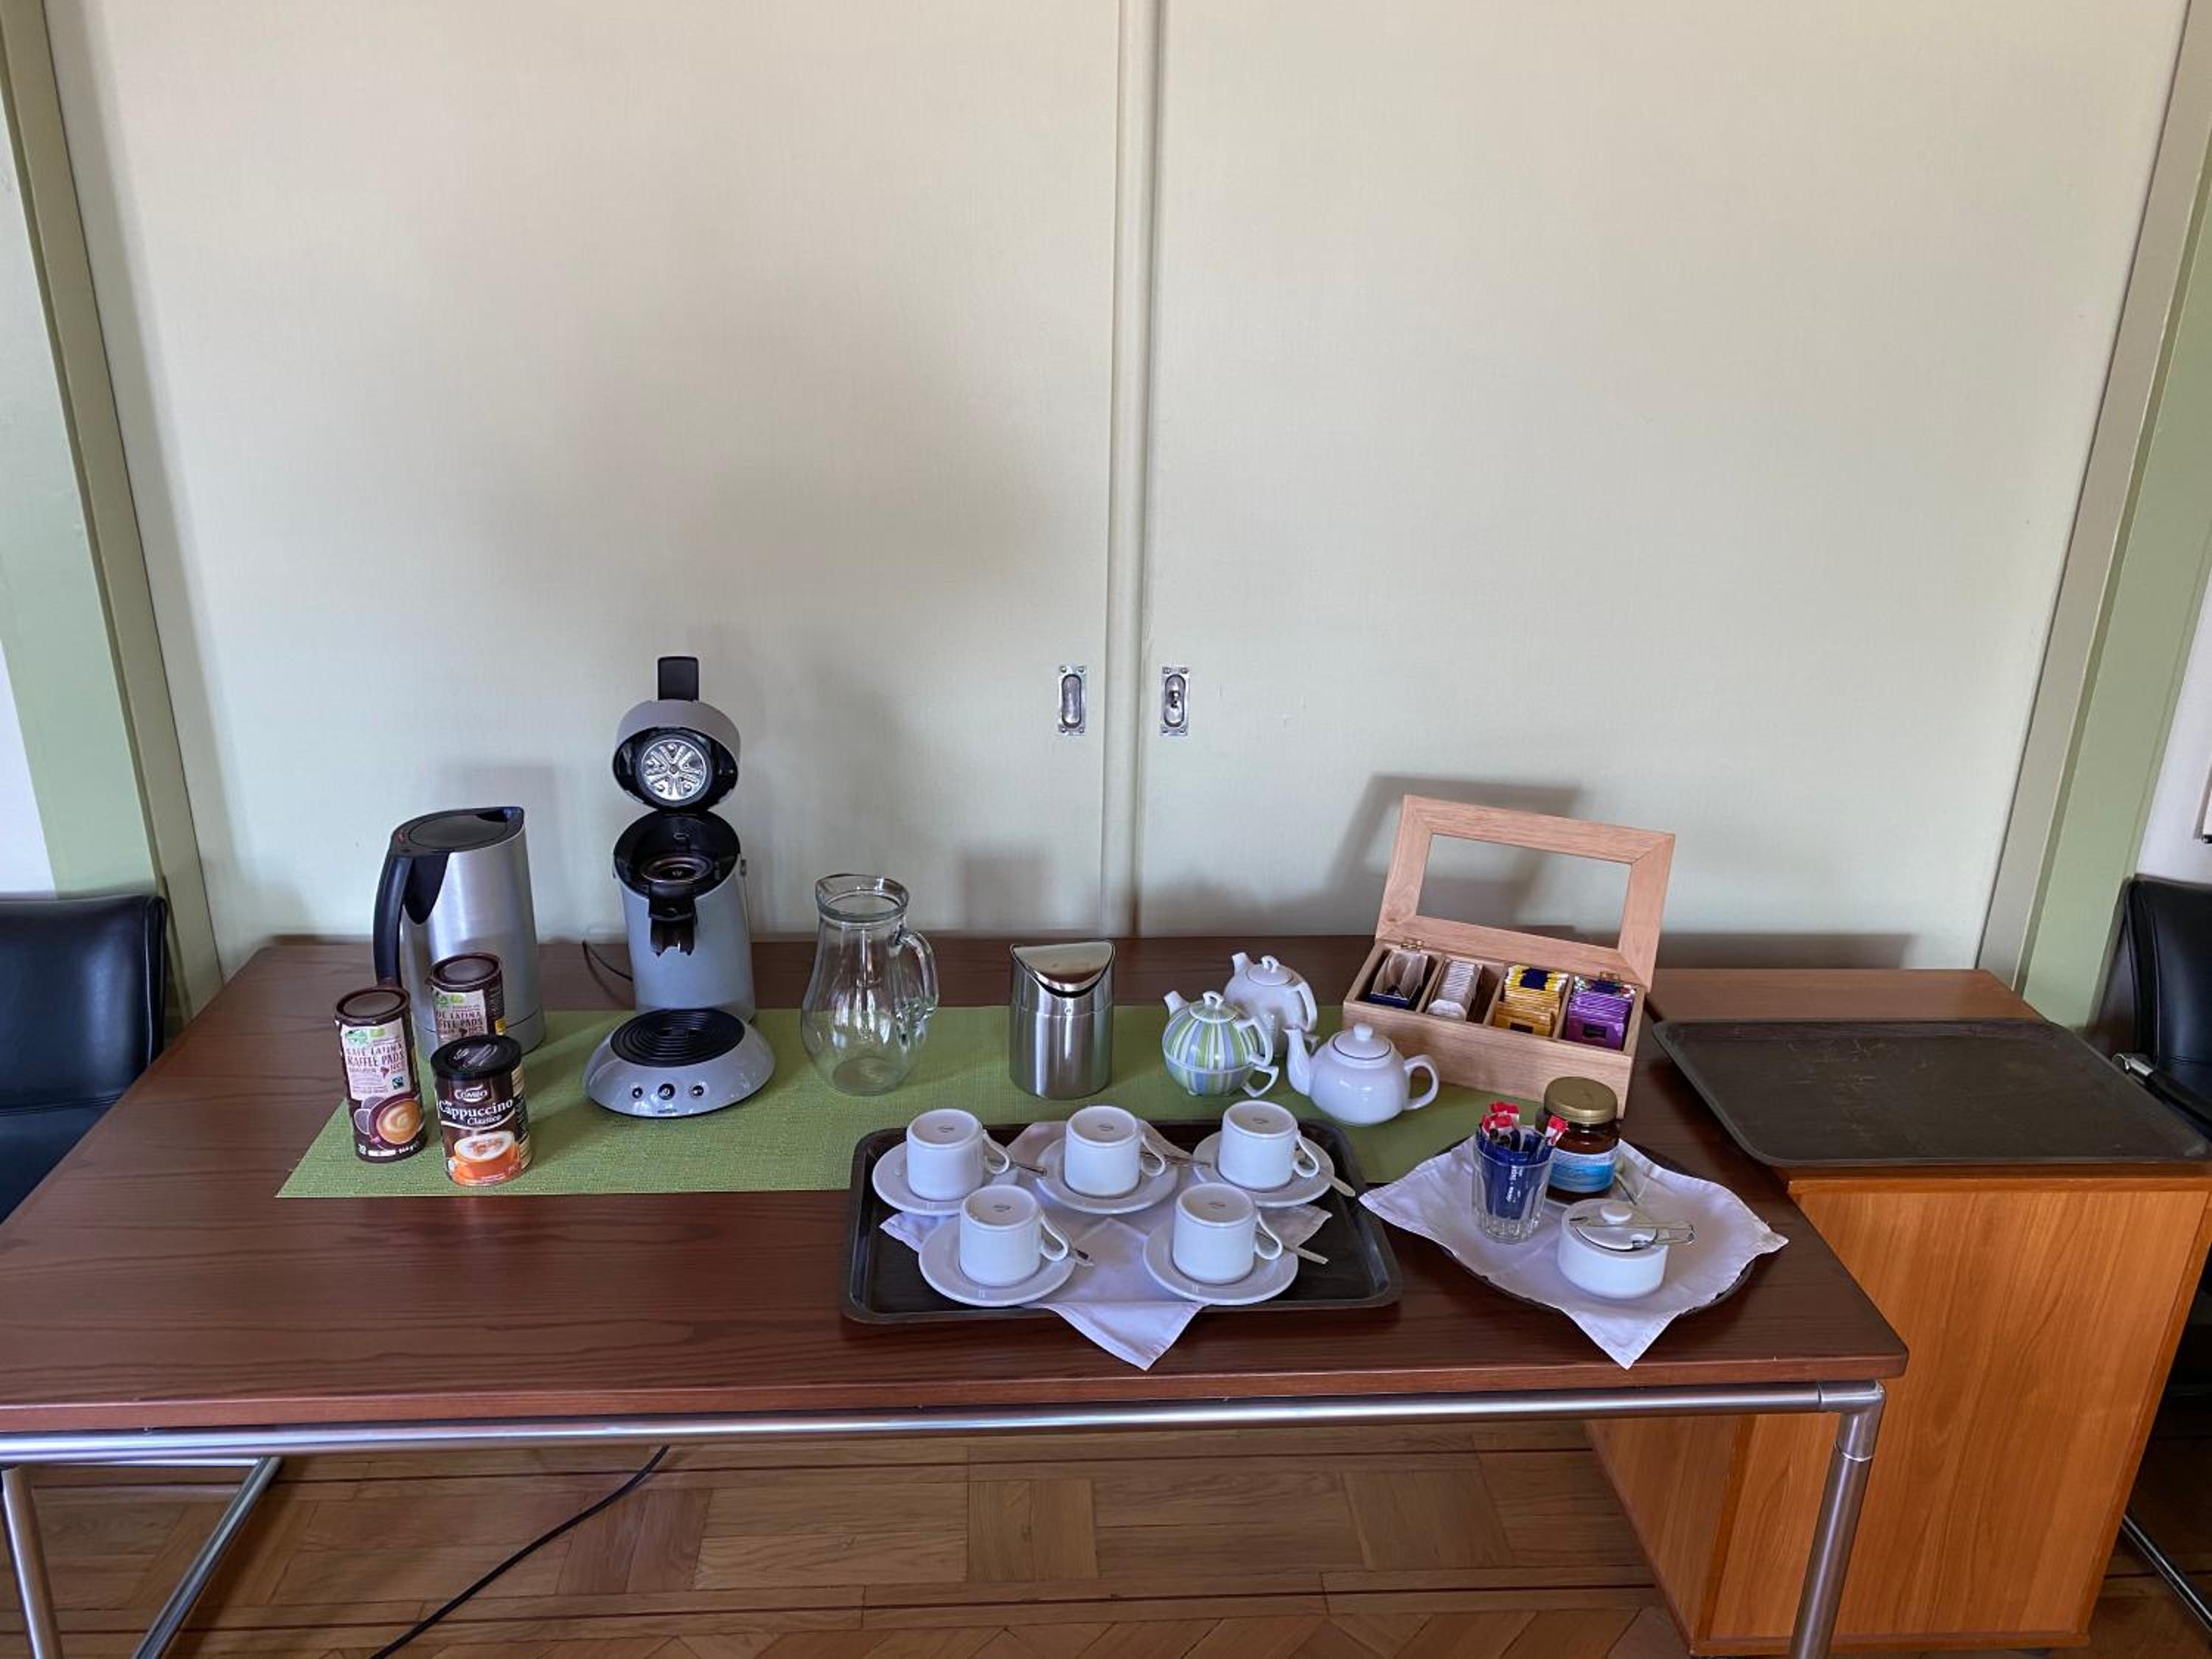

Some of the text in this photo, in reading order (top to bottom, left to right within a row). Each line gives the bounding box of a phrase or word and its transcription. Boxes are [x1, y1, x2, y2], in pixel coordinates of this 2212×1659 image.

[347, 1051, 404, 1067] KAFFEE PADS
[439, 1099, 513, 1120] Cappuccino
